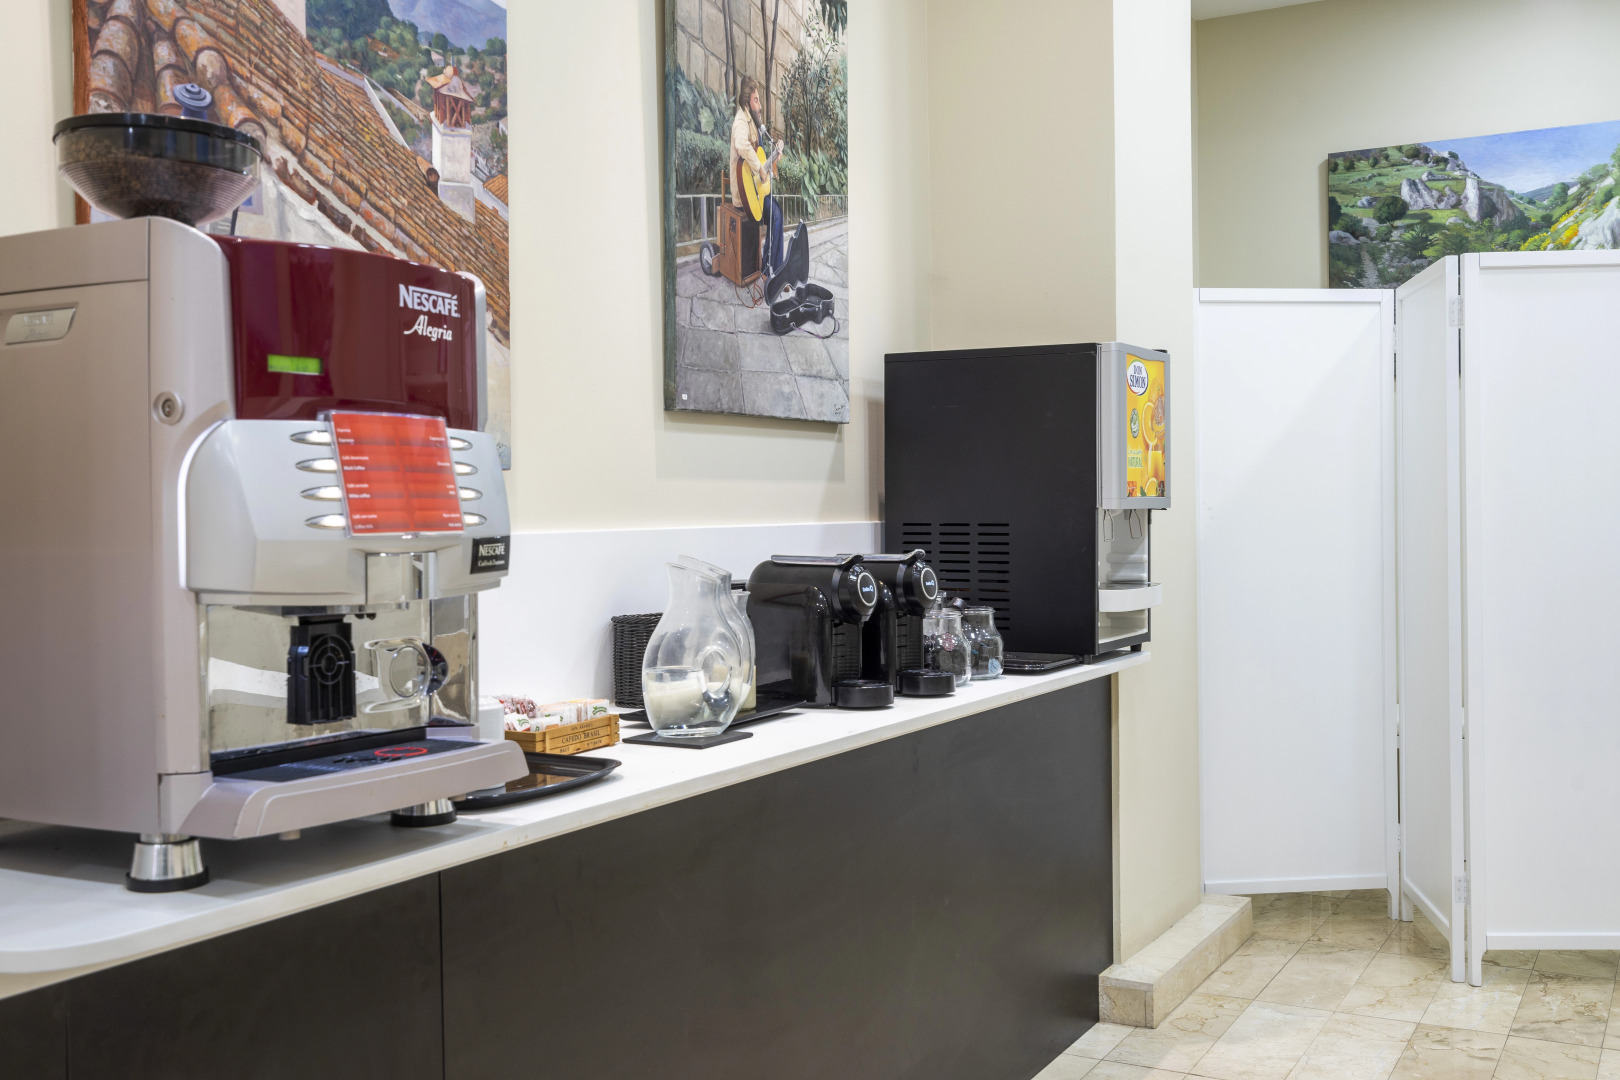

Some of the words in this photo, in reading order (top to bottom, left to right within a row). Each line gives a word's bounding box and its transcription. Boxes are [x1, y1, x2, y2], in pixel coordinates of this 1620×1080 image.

[399, 284, 460, 317] NESCAFÉ
[404, 315, 452, 341] Alegria
[1133, 365, 1142, 375] DON
[1130, 375, 1146, 388] SIMON
[1128, 456, 1143, 468] NATURAL
[479, 543, 505, 556] NESCAFÉ
[584, 730, 600, 739] BRASIL
